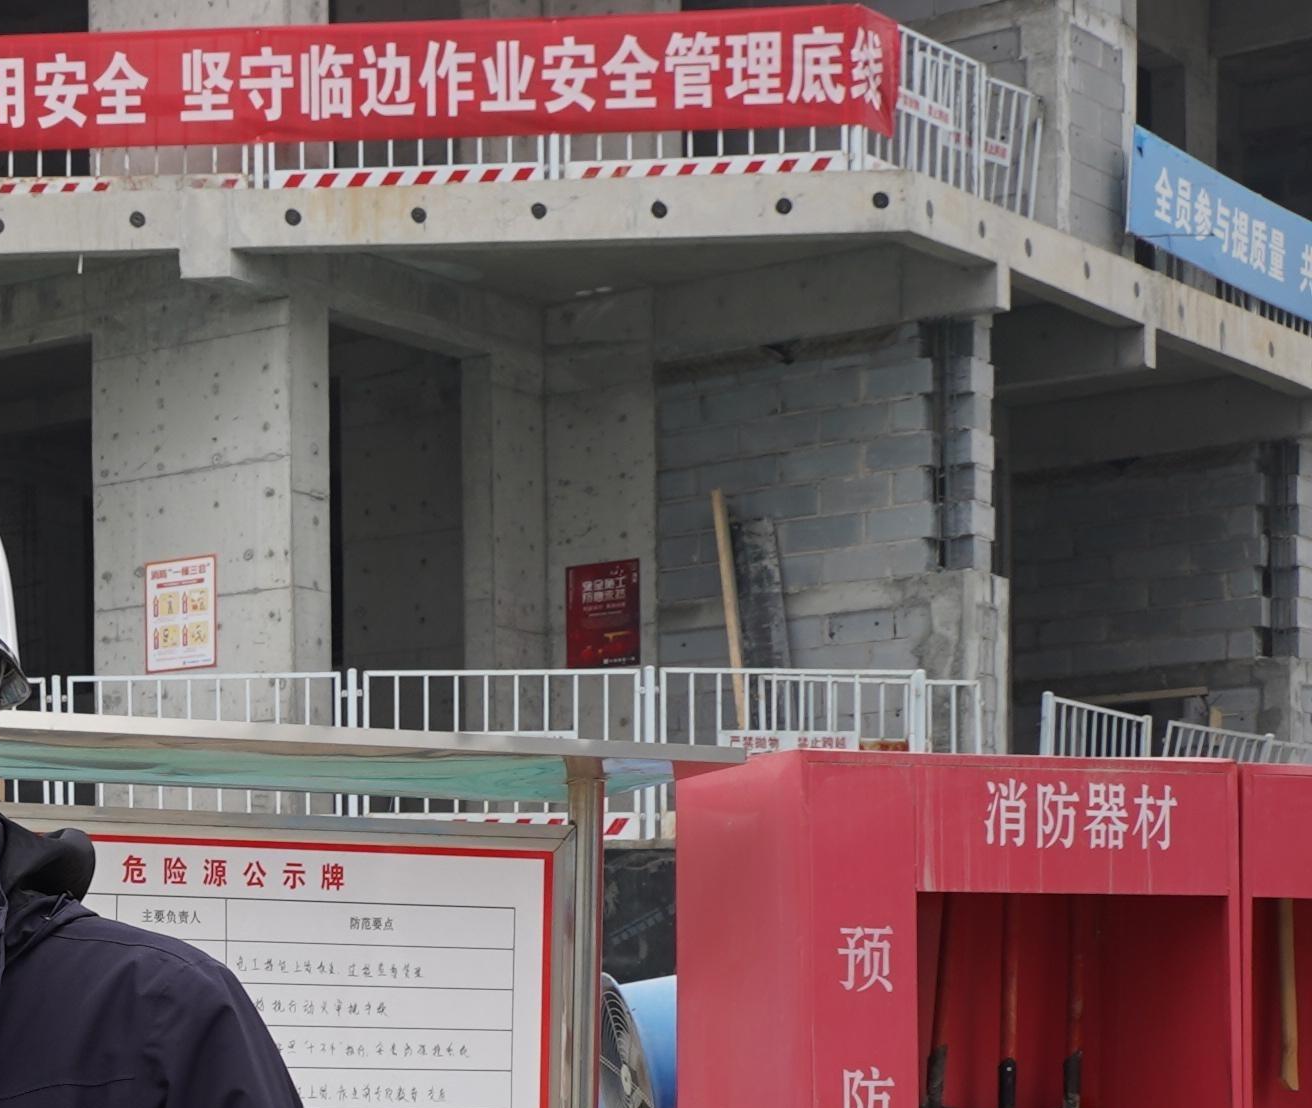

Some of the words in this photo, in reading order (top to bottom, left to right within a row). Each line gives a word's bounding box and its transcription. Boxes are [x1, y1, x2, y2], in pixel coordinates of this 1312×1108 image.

[180, 24, 884, 122] 坚守临边作业安全管理底线
[1153, 167, 1285, 282] 全员参与提质量
[983, 777, 1178, 850] 消防器材
[121, 854, 346, 891] 危险源公示牌
[141, 907, 201, 925] 主要负责人
[349, 915, 394, 932] 防范要点
